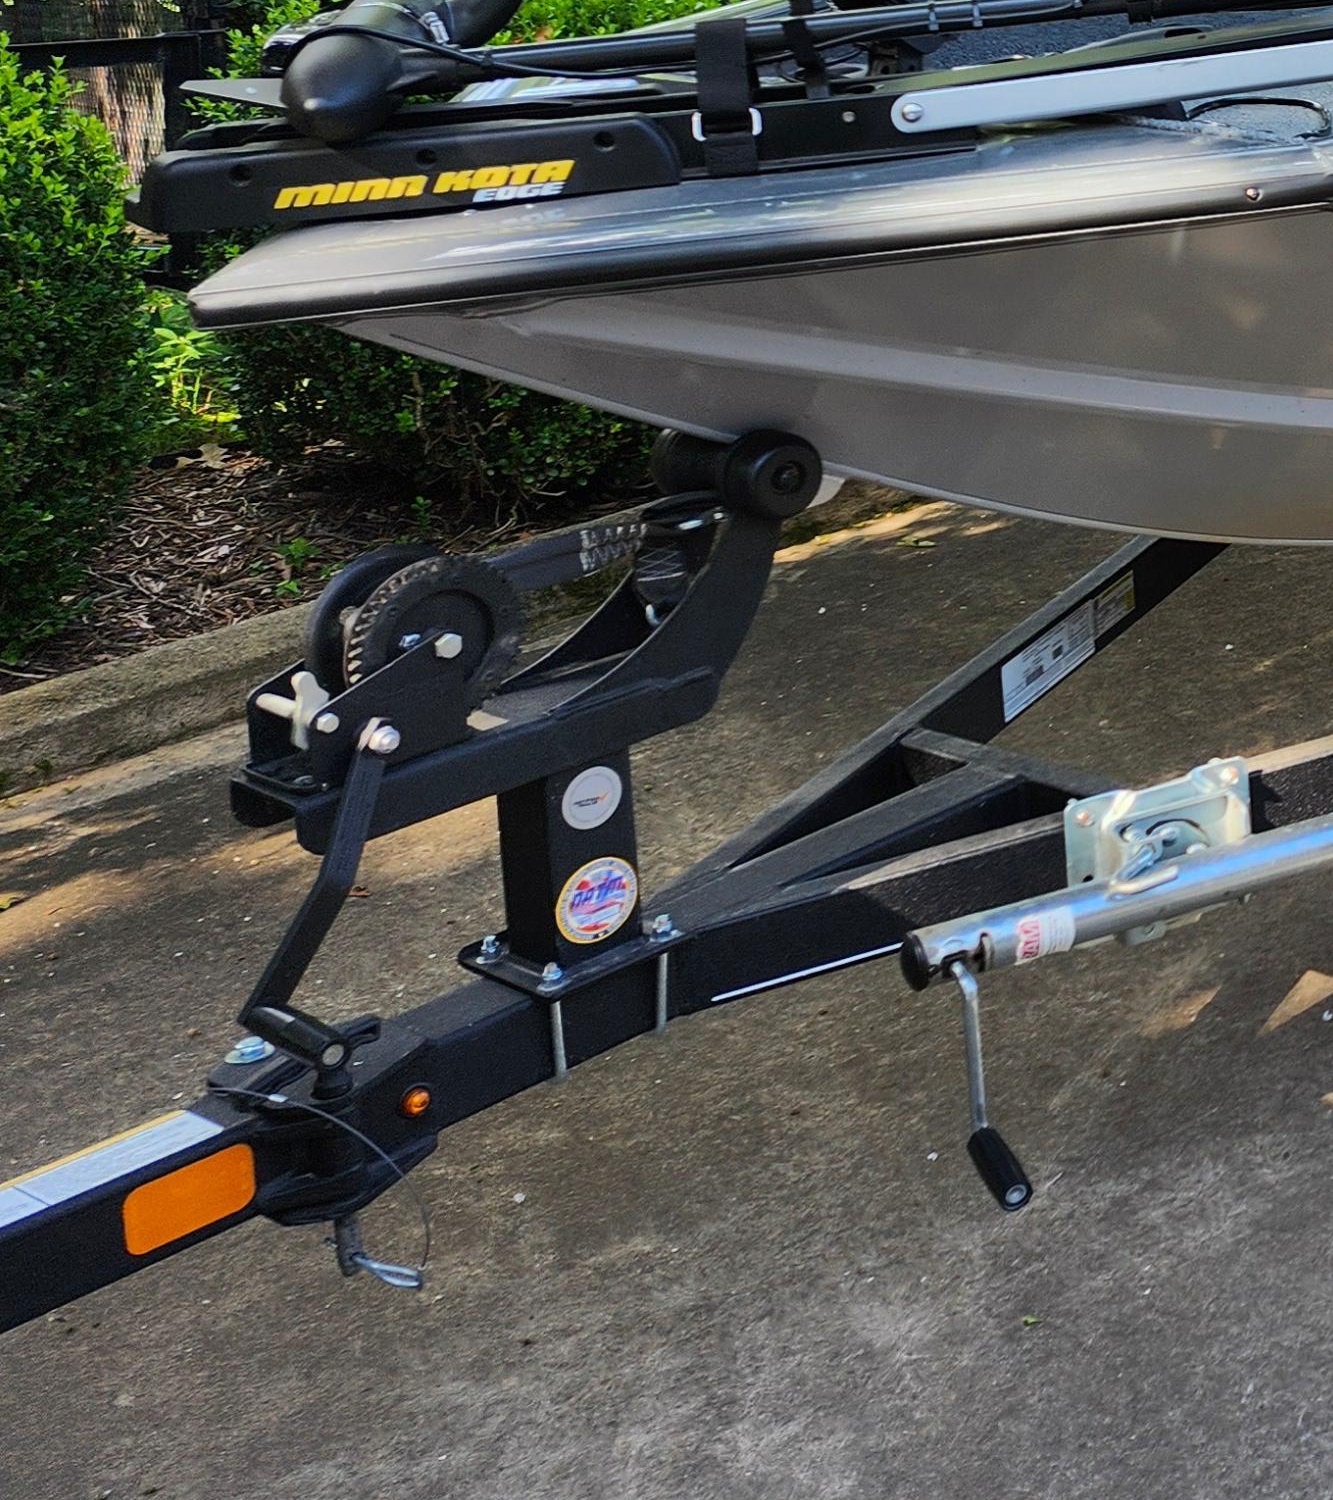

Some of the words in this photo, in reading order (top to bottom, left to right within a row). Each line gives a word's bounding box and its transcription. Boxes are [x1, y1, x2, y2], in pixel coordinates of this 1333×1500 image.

[273, 174, 428, 209] MINN
[432, 159, 576, 194] KOTA
[472, 181, 566, 203] EDGE
